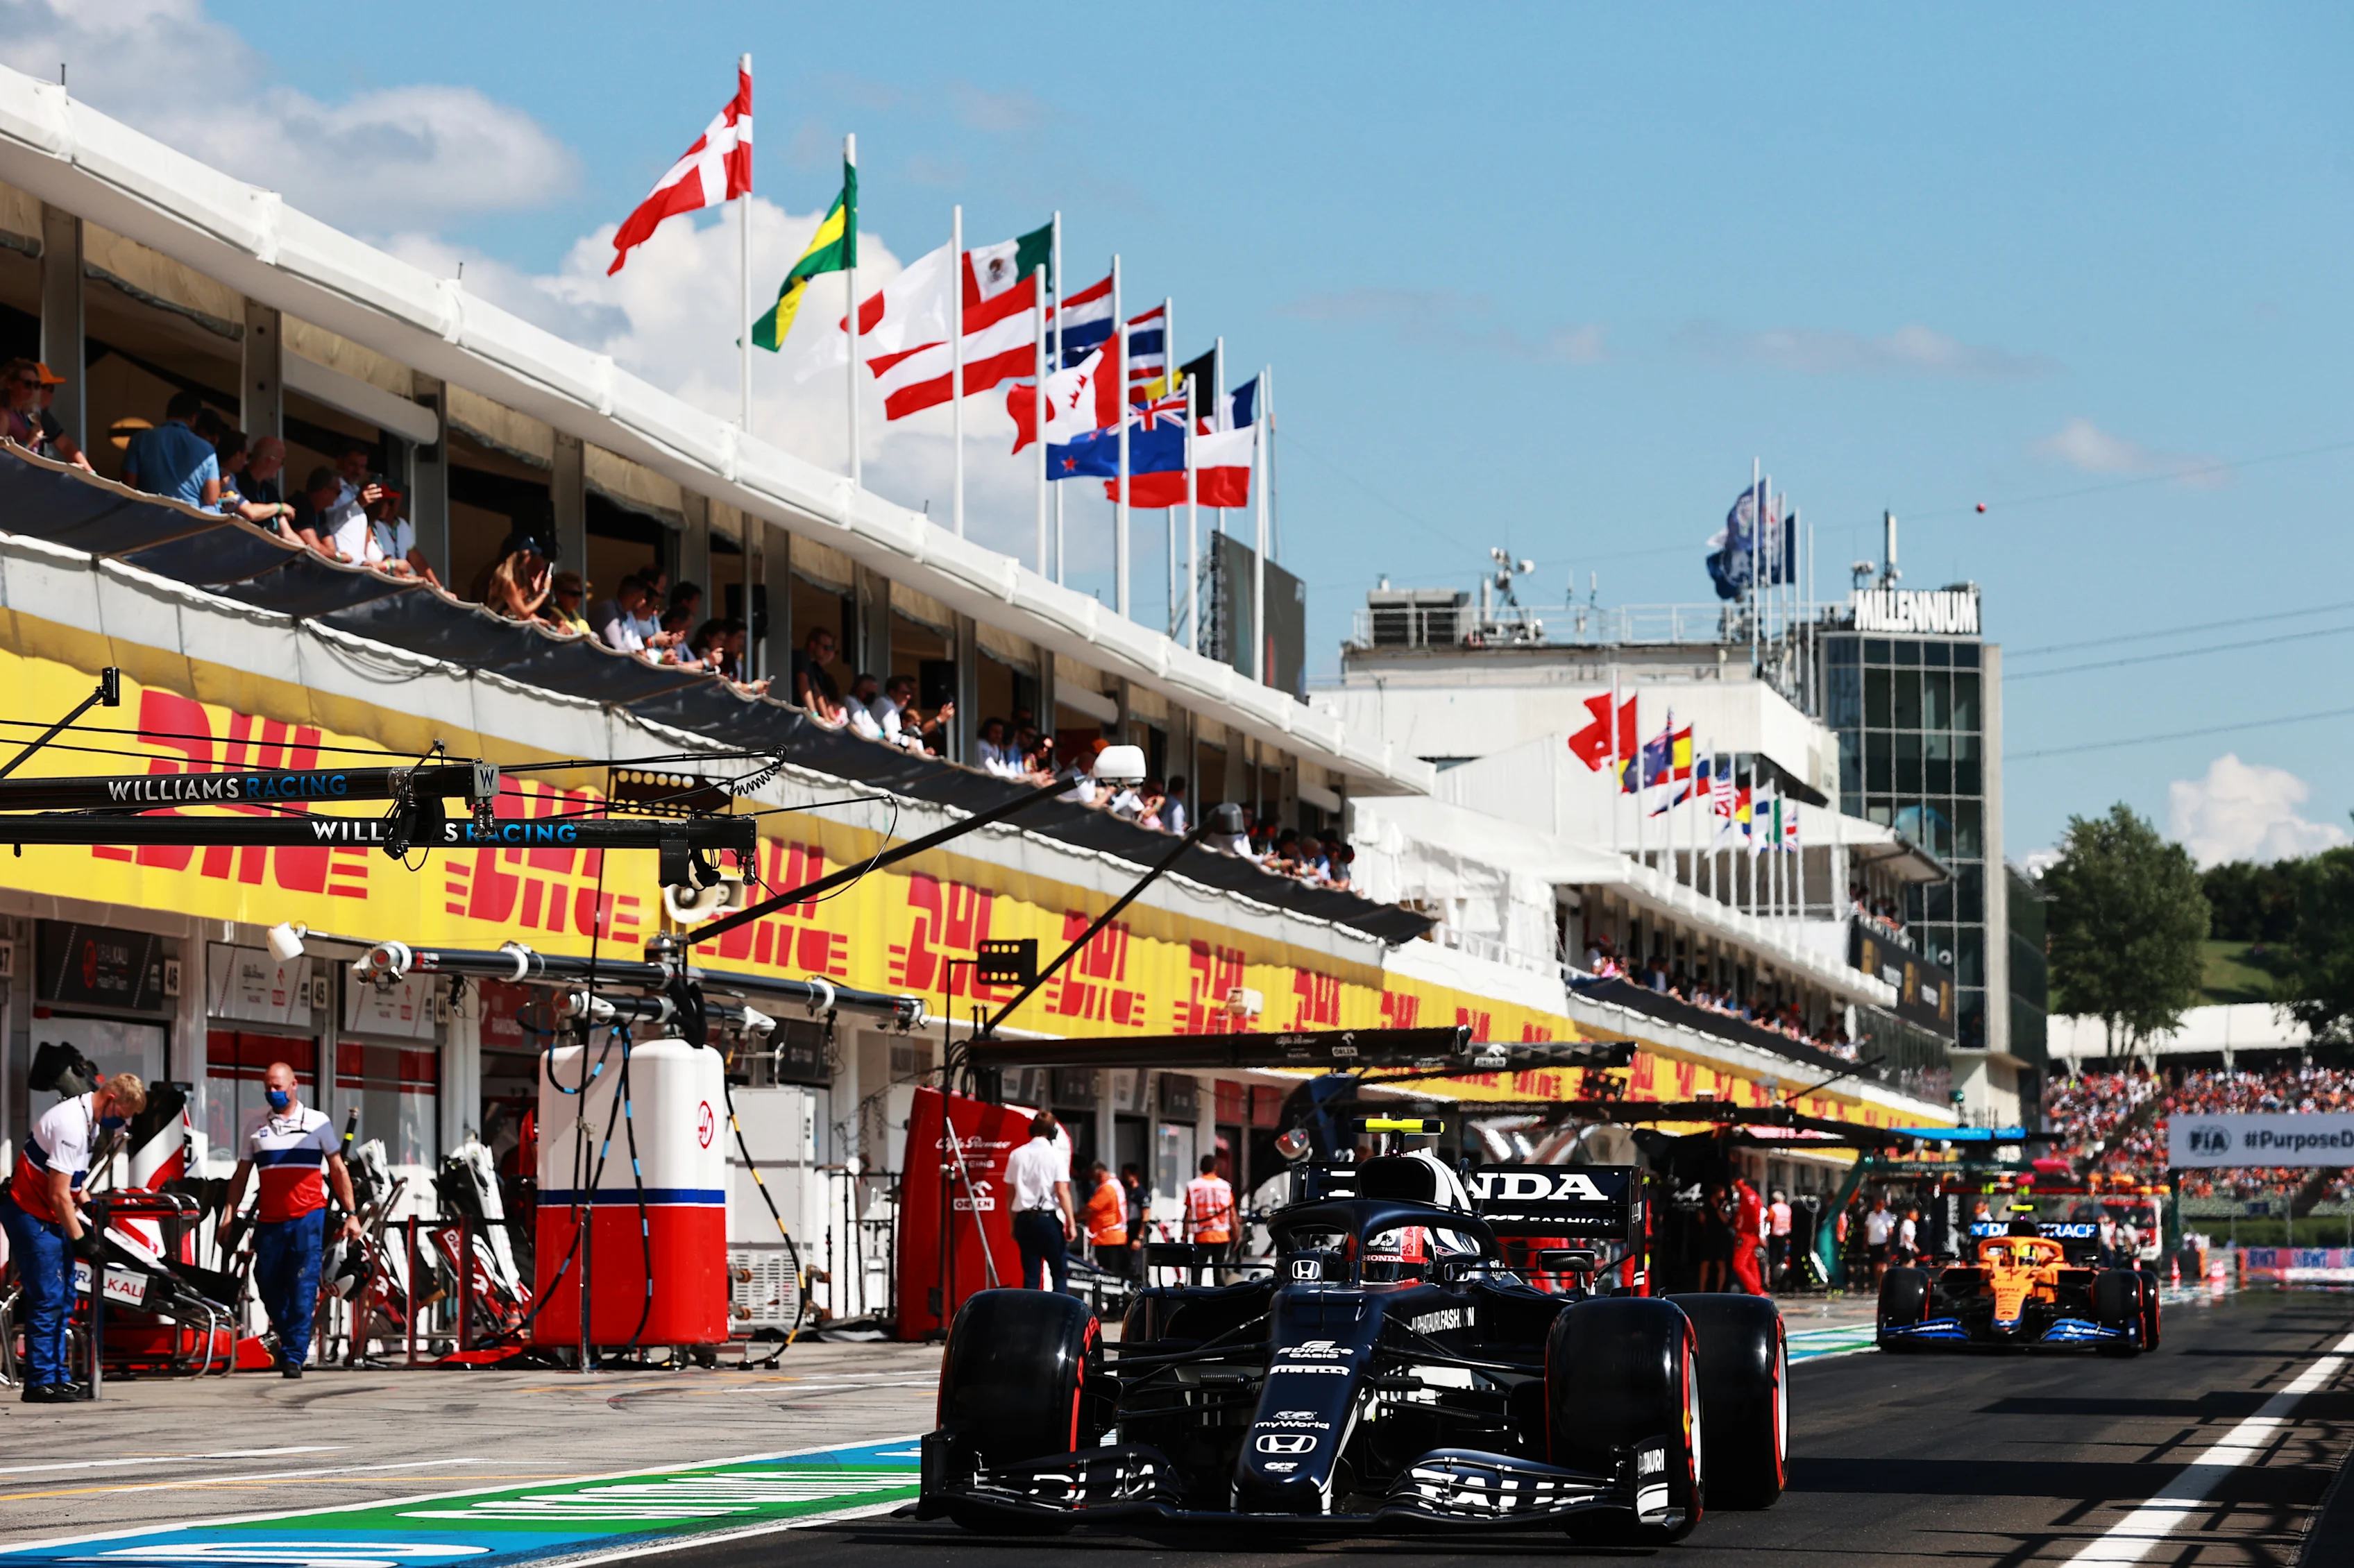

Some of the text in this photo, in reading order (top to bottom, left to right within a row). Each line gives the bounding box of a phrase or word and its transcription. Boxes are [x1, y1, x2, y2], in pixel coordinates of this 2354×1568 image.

[1854, 589, 1978, 634] MILLENNIUM
[108, 774, 346, 802] WILLIAMS RACING
[311, 821, 459, 842] WILLS
[1058, 909, 1132, 1025] DHL
[2190, 1132, 2226, 1151] FIA
[1468, 1173, 1609, 1200] NDA
[955, 1200, 992, 1210] OREN
[1362, 1254, 1405, 1263] HONDA
[1277, 1347, 1355, 1355] EDIFICE
[1269, 1364, 1350, 1377] PIRELLI
[1254, 1421, 1330, 1430] myWorld
